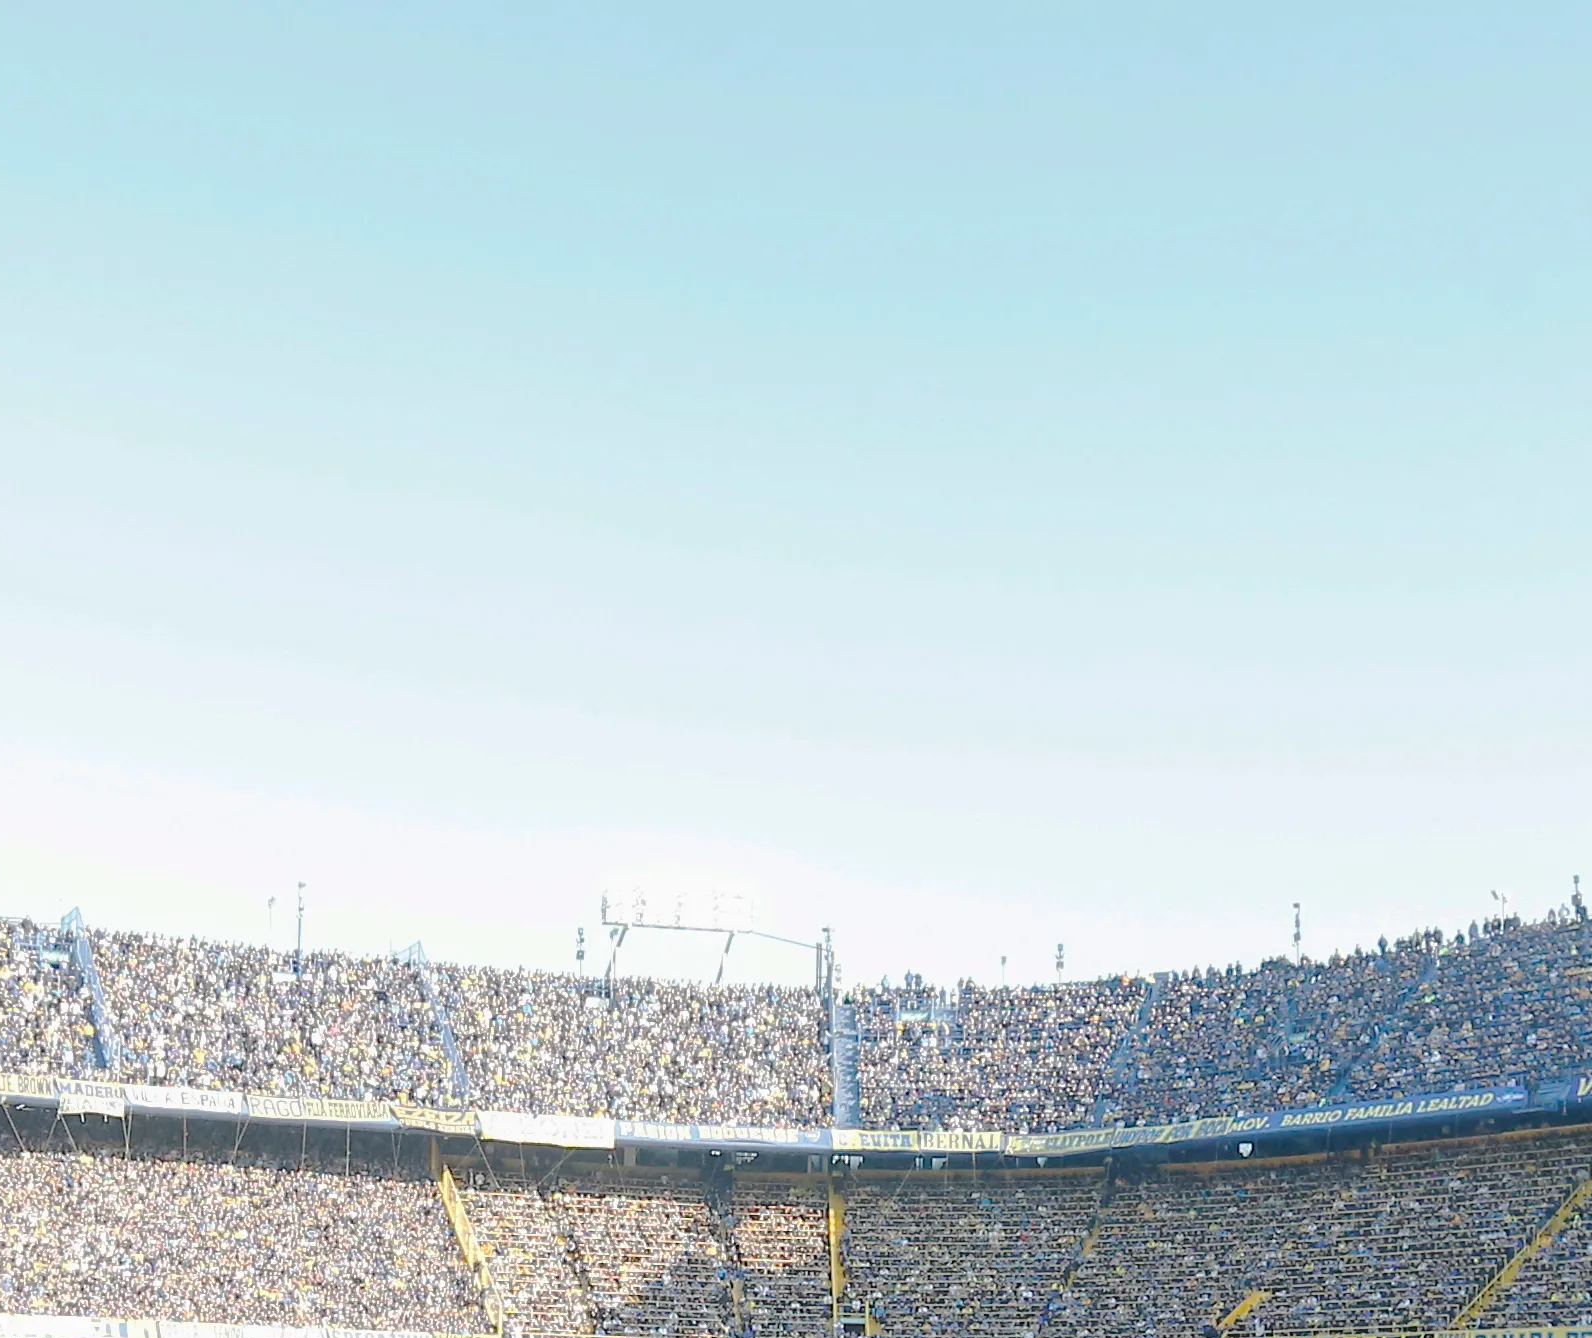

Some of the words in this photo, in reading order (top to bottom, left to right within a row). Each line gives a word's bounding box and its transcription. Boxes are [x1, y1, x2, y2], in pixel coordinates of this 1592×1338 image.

[1231, 1116, 1271, 1133] MOV.
[1280, 1109, 1343, 1127] BARRIO
[1343, 1101, 1414, 1121] FAMILIA
[1415, 1091, 1496, 1114] LEALTAD
[921, 1130, 999, 1150] BERNAL
